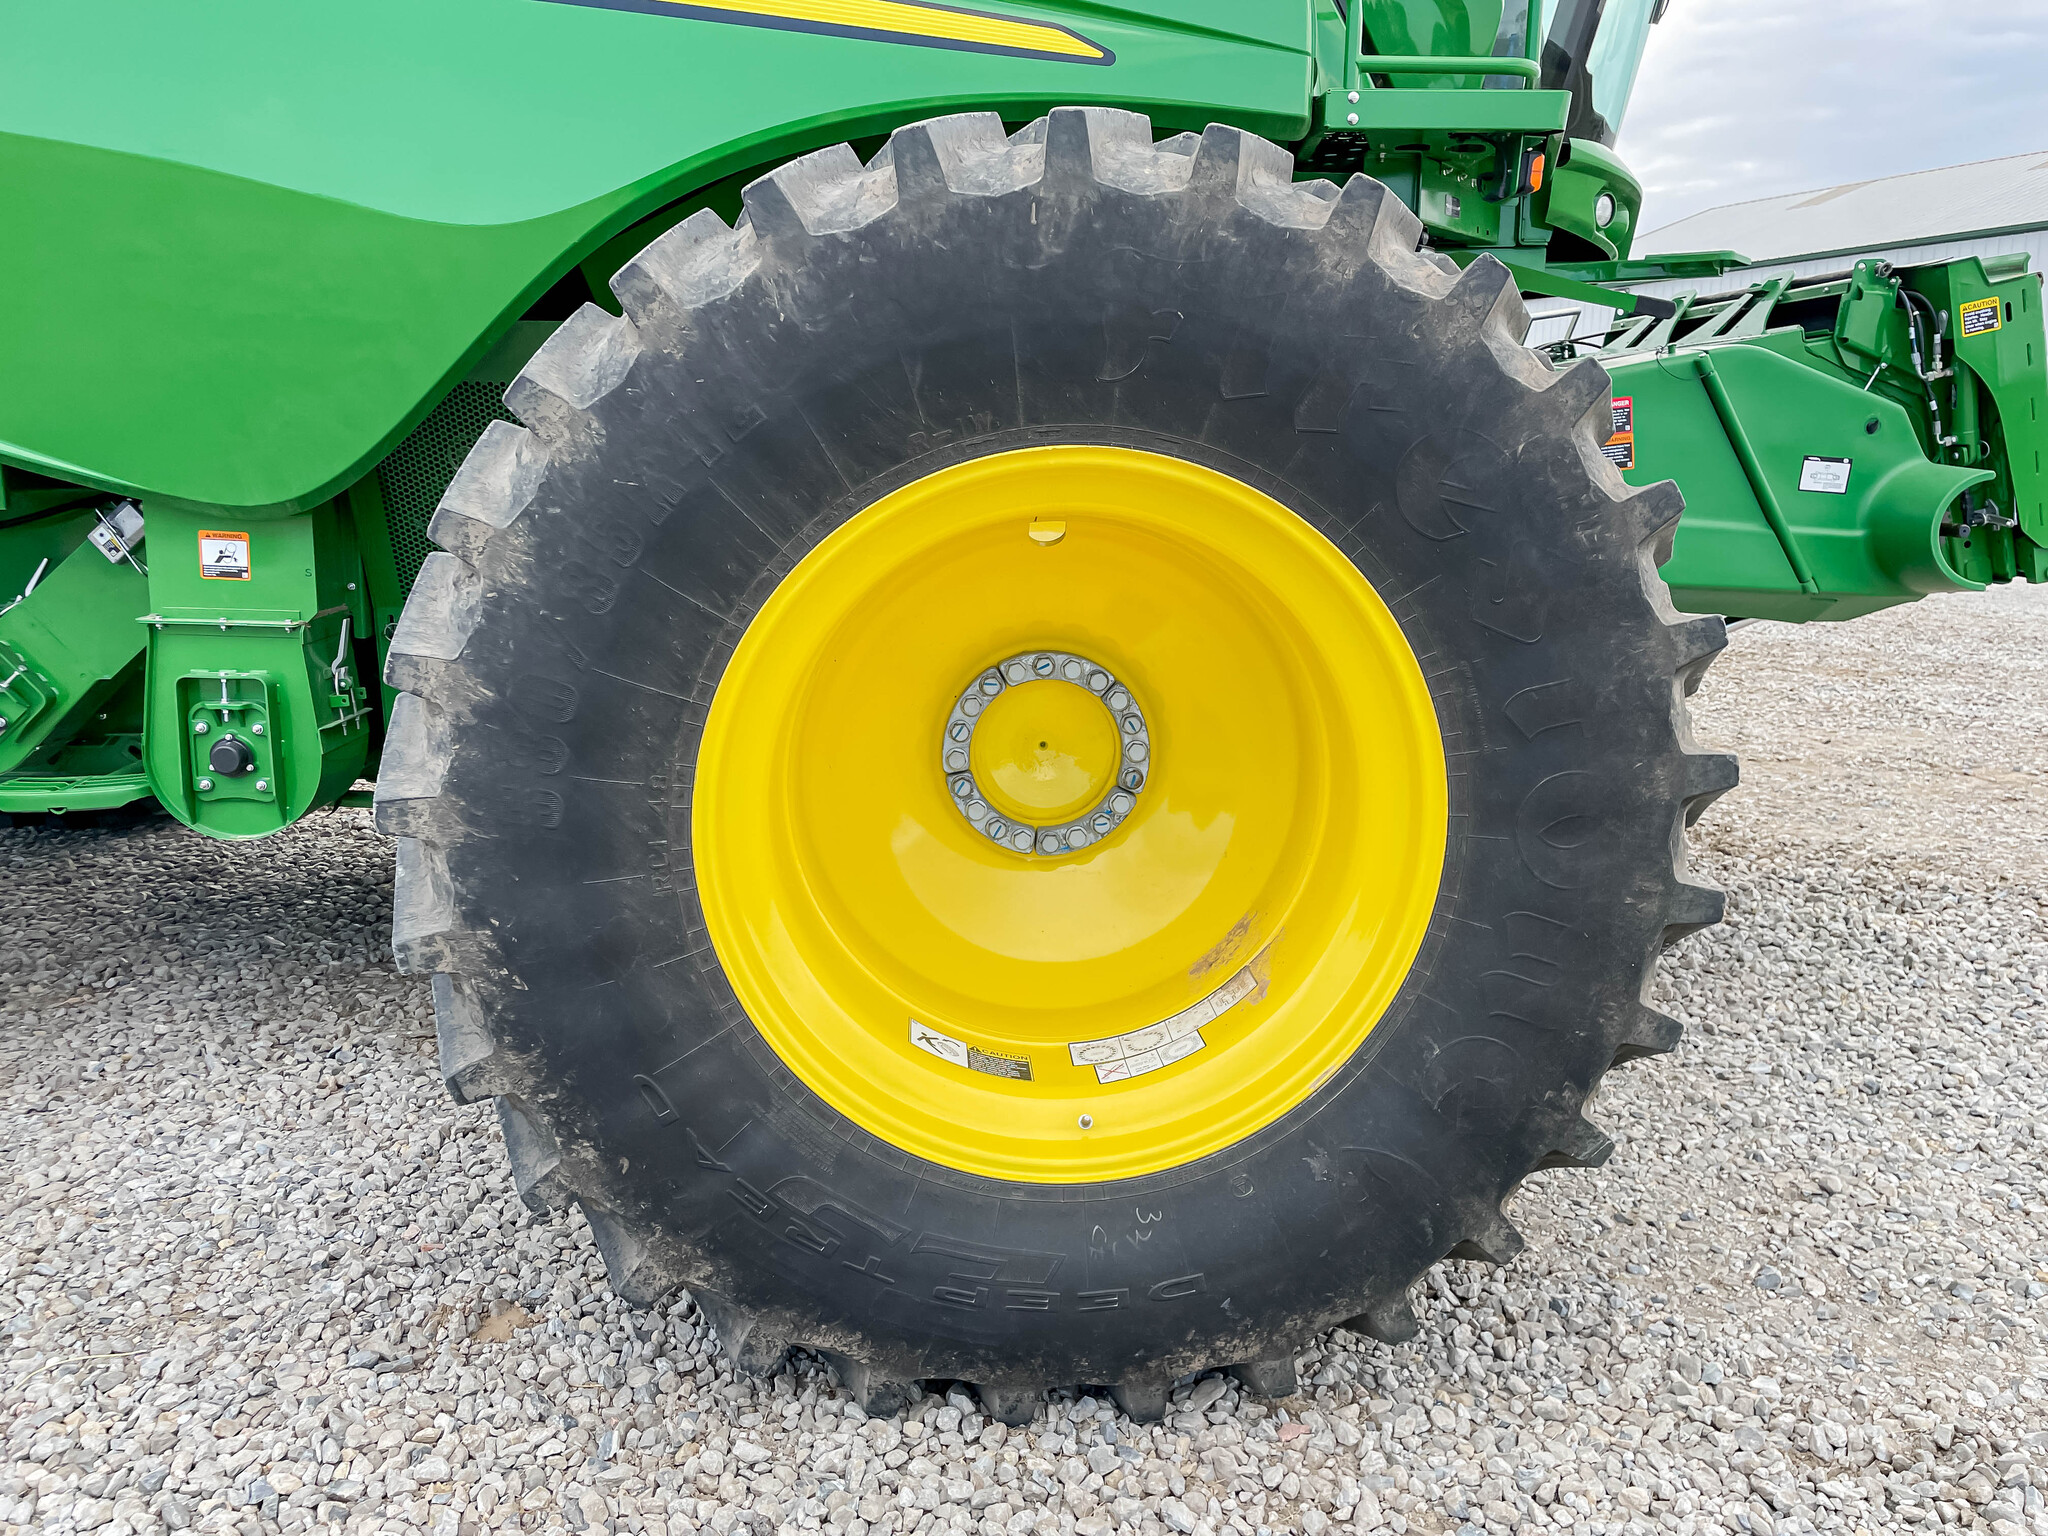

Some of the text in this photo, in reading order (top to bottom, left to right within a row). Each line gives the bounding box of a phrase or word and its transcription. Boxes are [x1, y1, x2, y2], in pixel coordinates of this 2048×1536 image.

[1967, 298, 1998, 310] CAUTION
[211, 532, 243, 540] WARNING
[981, 1048, 1029, 1061] CAUTION
[632, 1072, 896, 1286] TREAD
[933, 1272, 1206, 1314] DEEP
